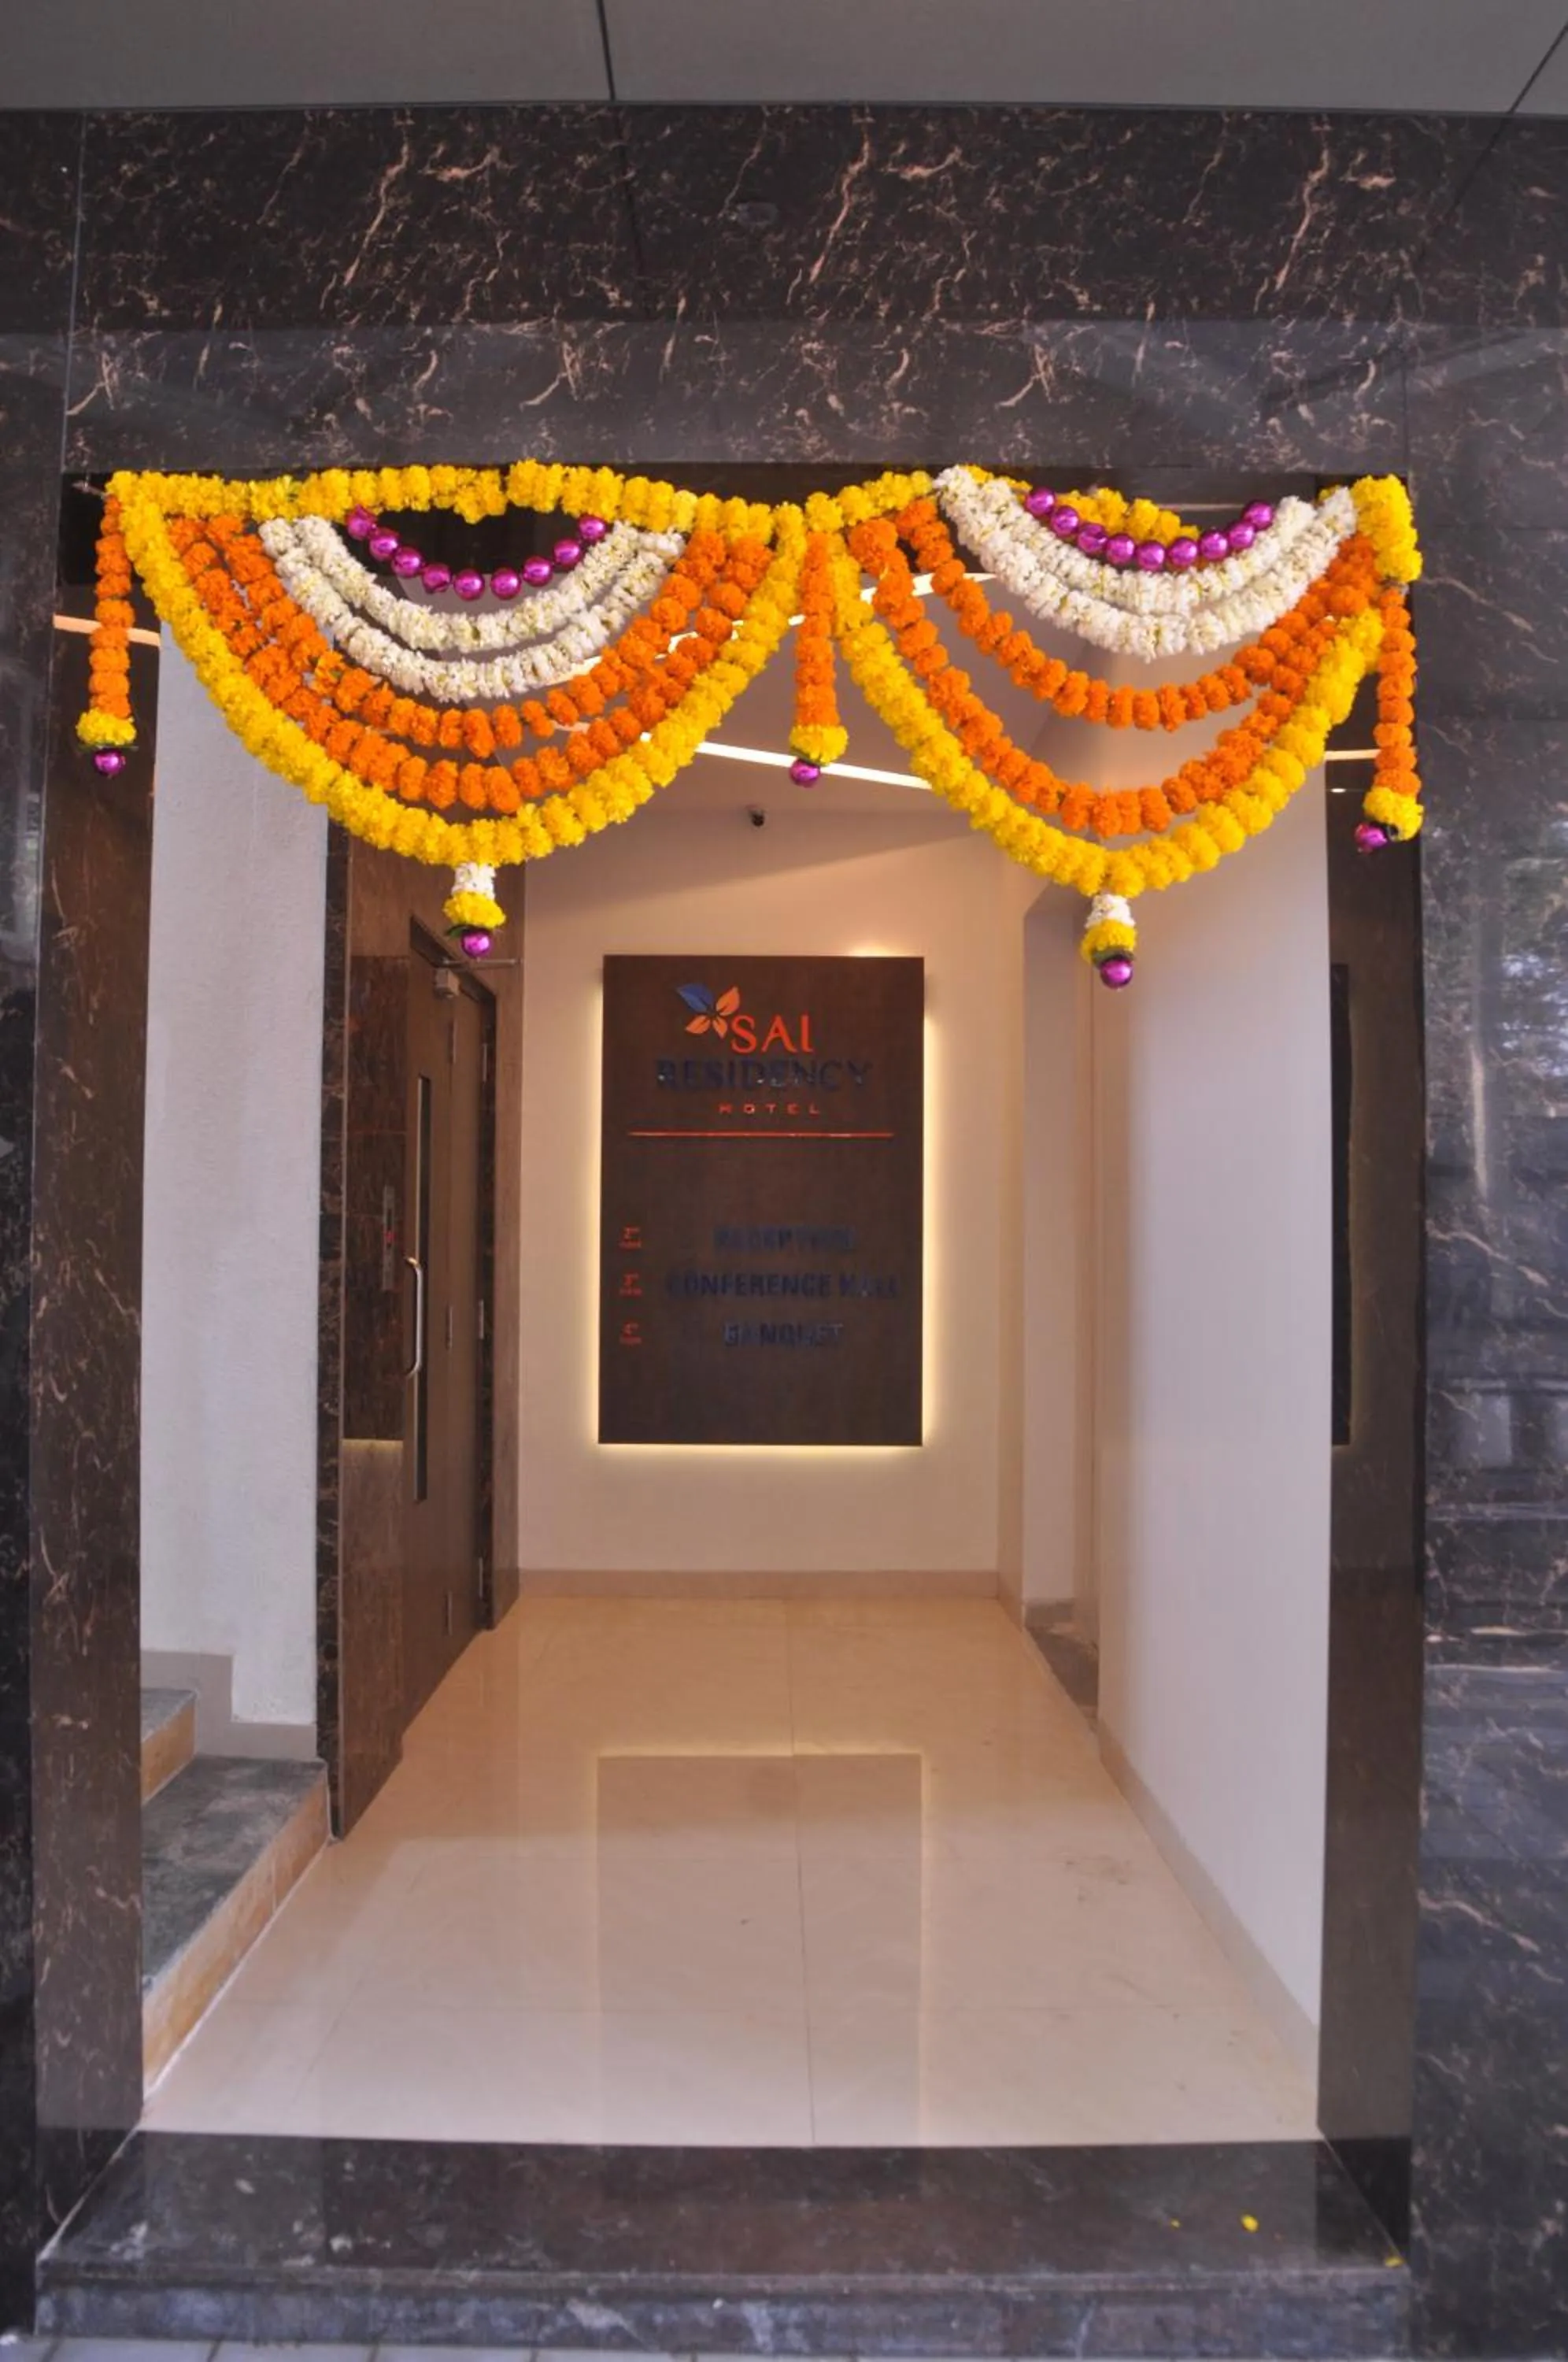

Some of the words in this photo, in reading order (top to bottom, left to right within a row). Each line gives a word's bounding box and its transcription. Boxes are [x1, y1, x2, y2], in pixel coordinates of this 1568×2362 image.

[730, 1014, 814, 1053] SAI
[655, 1060, 873, 1091] RESIDENCY
[719, 1103, 821, 1115] HOTEL
[665, 1271, 831, 1298] CONFERENCE
